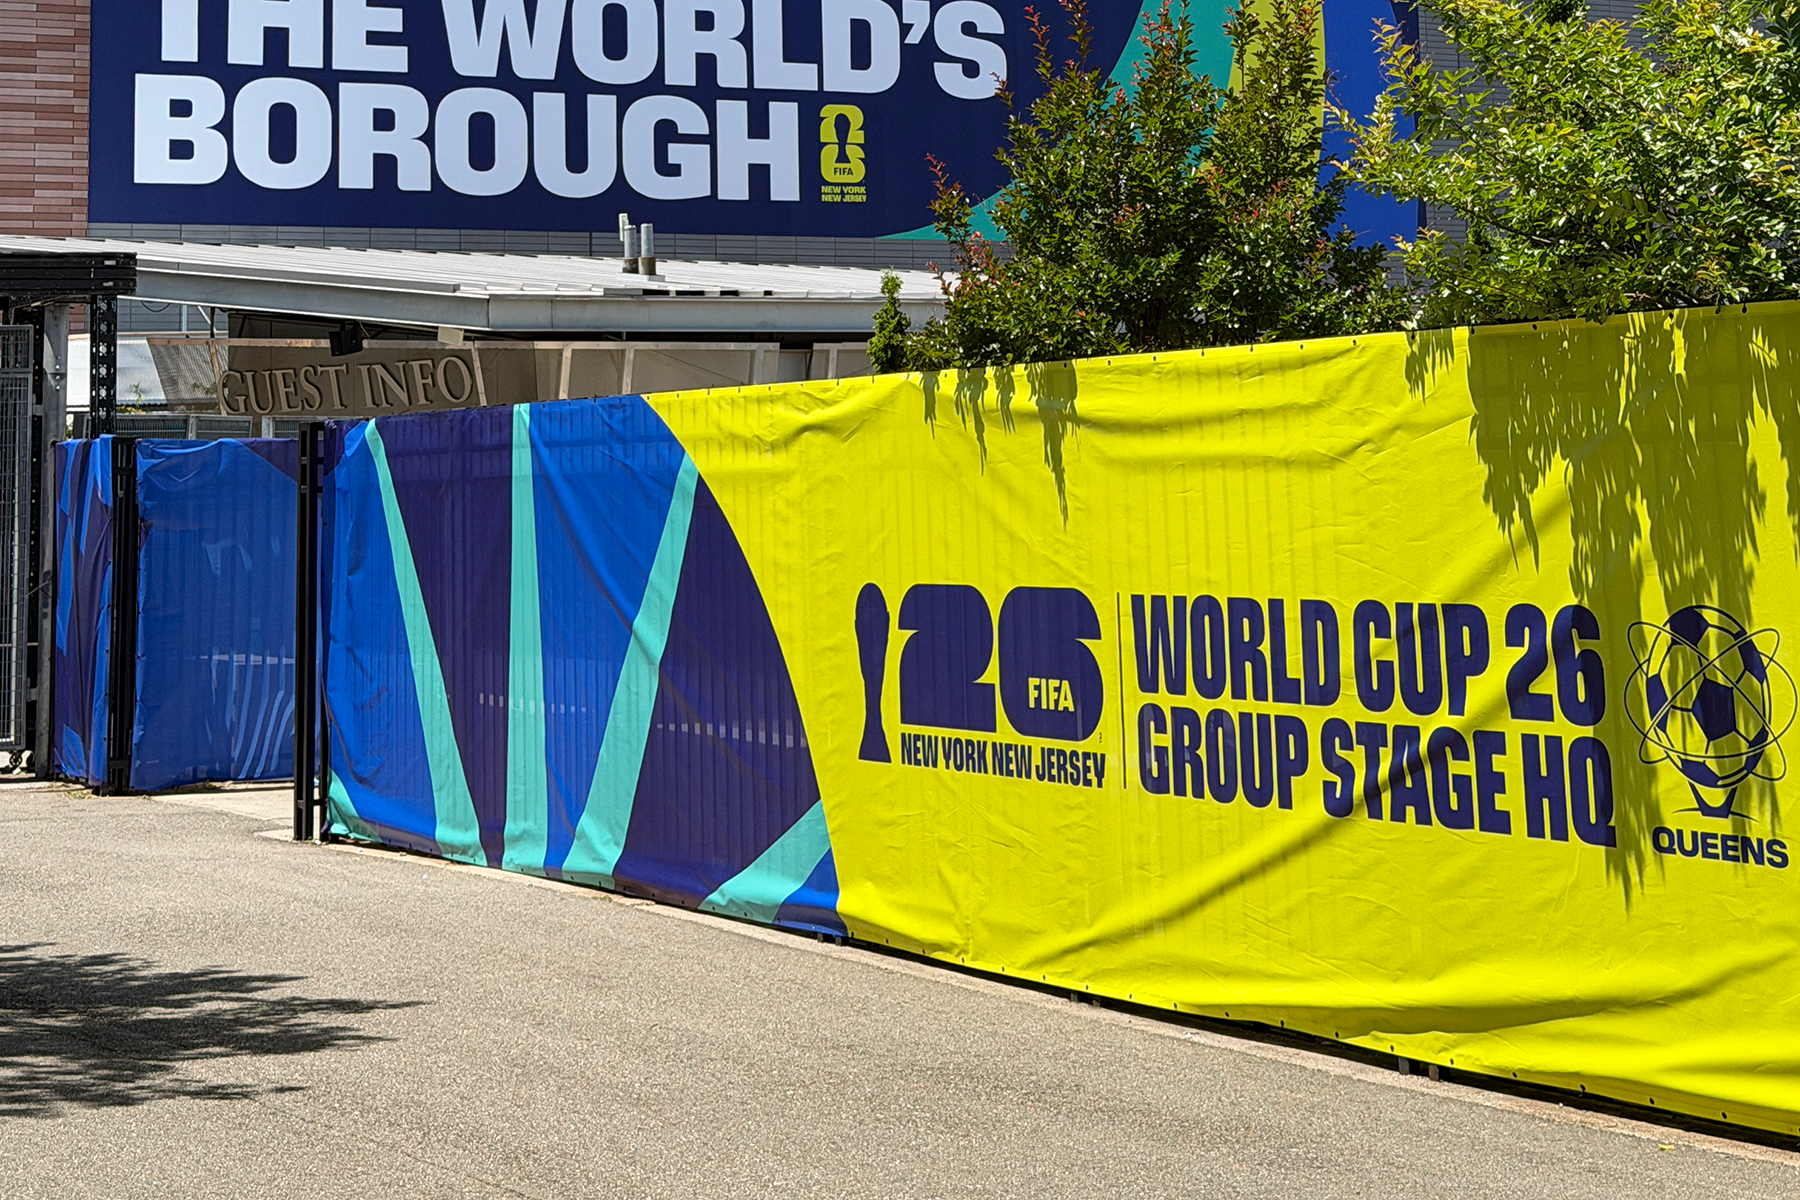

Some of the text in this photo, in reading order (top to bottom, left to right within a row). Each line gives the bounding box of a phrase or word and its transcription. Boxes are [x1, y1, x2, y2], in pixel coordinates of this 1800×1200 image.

[134, 73, 800, 201] BOROUGH
[821, 186, 866, 194] NEW YORK
[833, 167, 854, 176] FIFA
[843, 195, 867, 203] JERSEY
[217, 356, 473, 415] GUEST INFO
[1132, 594, 1606, 726] WORLD CUP 26
[1028, 677, 1075, 712] FIFA
[900, 732, 1106, 789] NEW YORK NEW JERSEY
[1138, 703, 1616, 848] GROUP STAGE HQ
[1652, 826, 1789, 868] QUEENS
